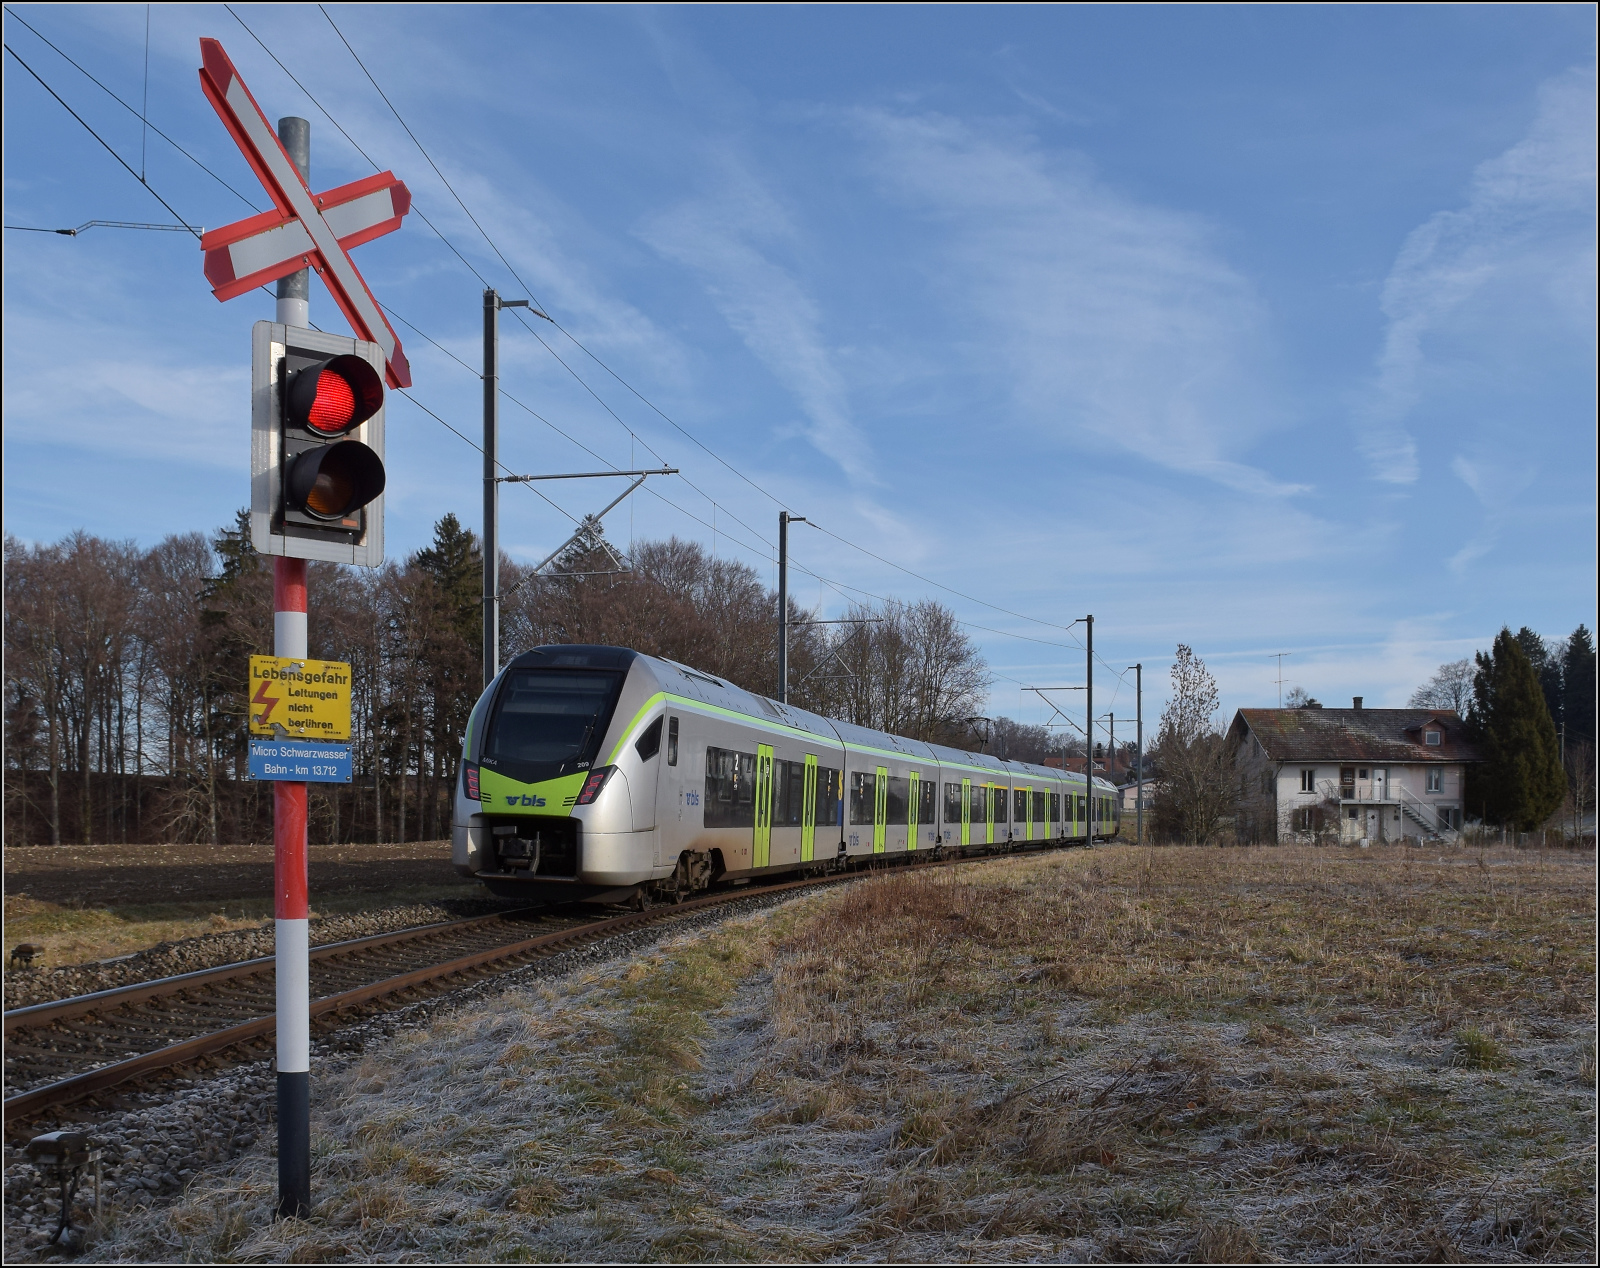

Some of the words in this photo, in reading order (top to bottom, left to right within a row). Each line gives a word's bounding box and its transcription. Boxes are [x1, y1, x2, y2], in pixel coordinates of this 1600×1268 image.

[253, 666, 348, 685] Lebensgefahr
[288, 687, 338, 701] Leitungen
[288, 704, 314, 713] nicht
[288, 718, 333, 729] berühren
[252, 746, 278, 757] Micro
[280, 747, 348, 759] Schwarzwasser
[482, 757, 498, 766] MIKA
[264, 763, 288, 774] Bahn
[295, 765, 309, 775] km
[312, 766, 337, 776] 13.712
[521, 794, 547, 807] bls
[691, 790, 700, 806] bls
